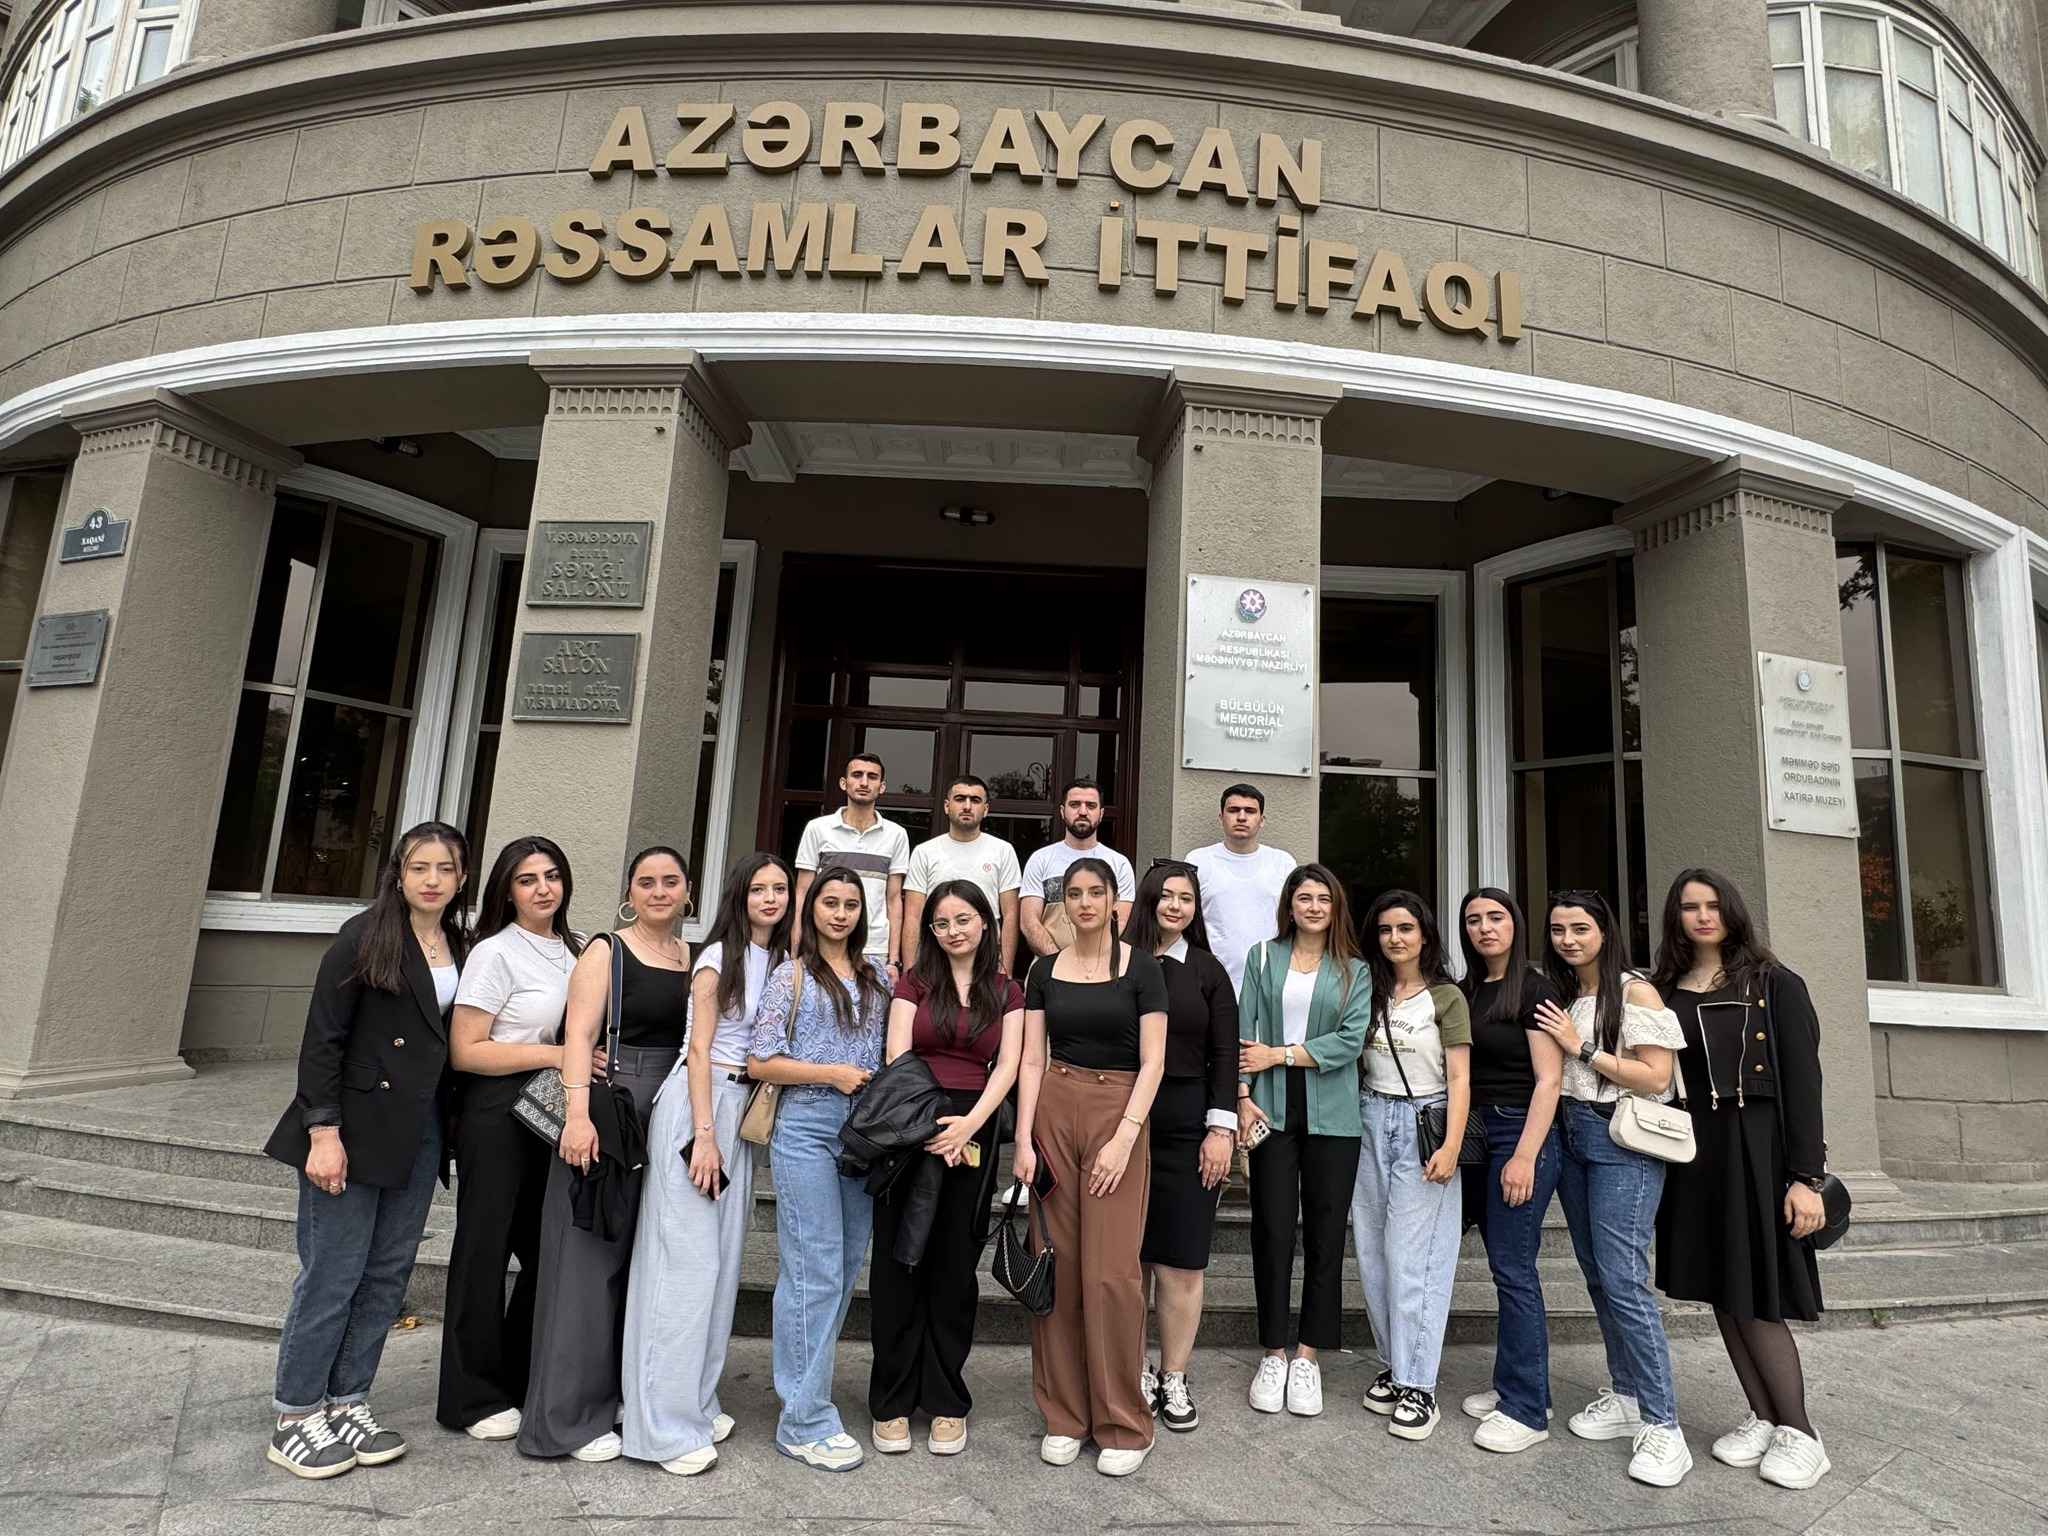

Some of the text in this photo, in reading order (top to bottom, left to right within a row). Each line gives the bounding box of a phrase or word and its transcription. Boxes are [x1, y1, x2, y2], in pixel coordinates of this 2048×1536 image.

[588, 101, 1322, 211] AZƏRBAYCAN
[410, 200, 1521, 343] RƏSSAMLAR İTTİFAQI
[89, 516, 103, 529] 43
[542, 580, 632, 599] SALONU
[1220, 629, 1288, 643] AZƏRBAYCAN
[556, 639, 602, 658] ART
[542, 656, 613, 675] SALON
